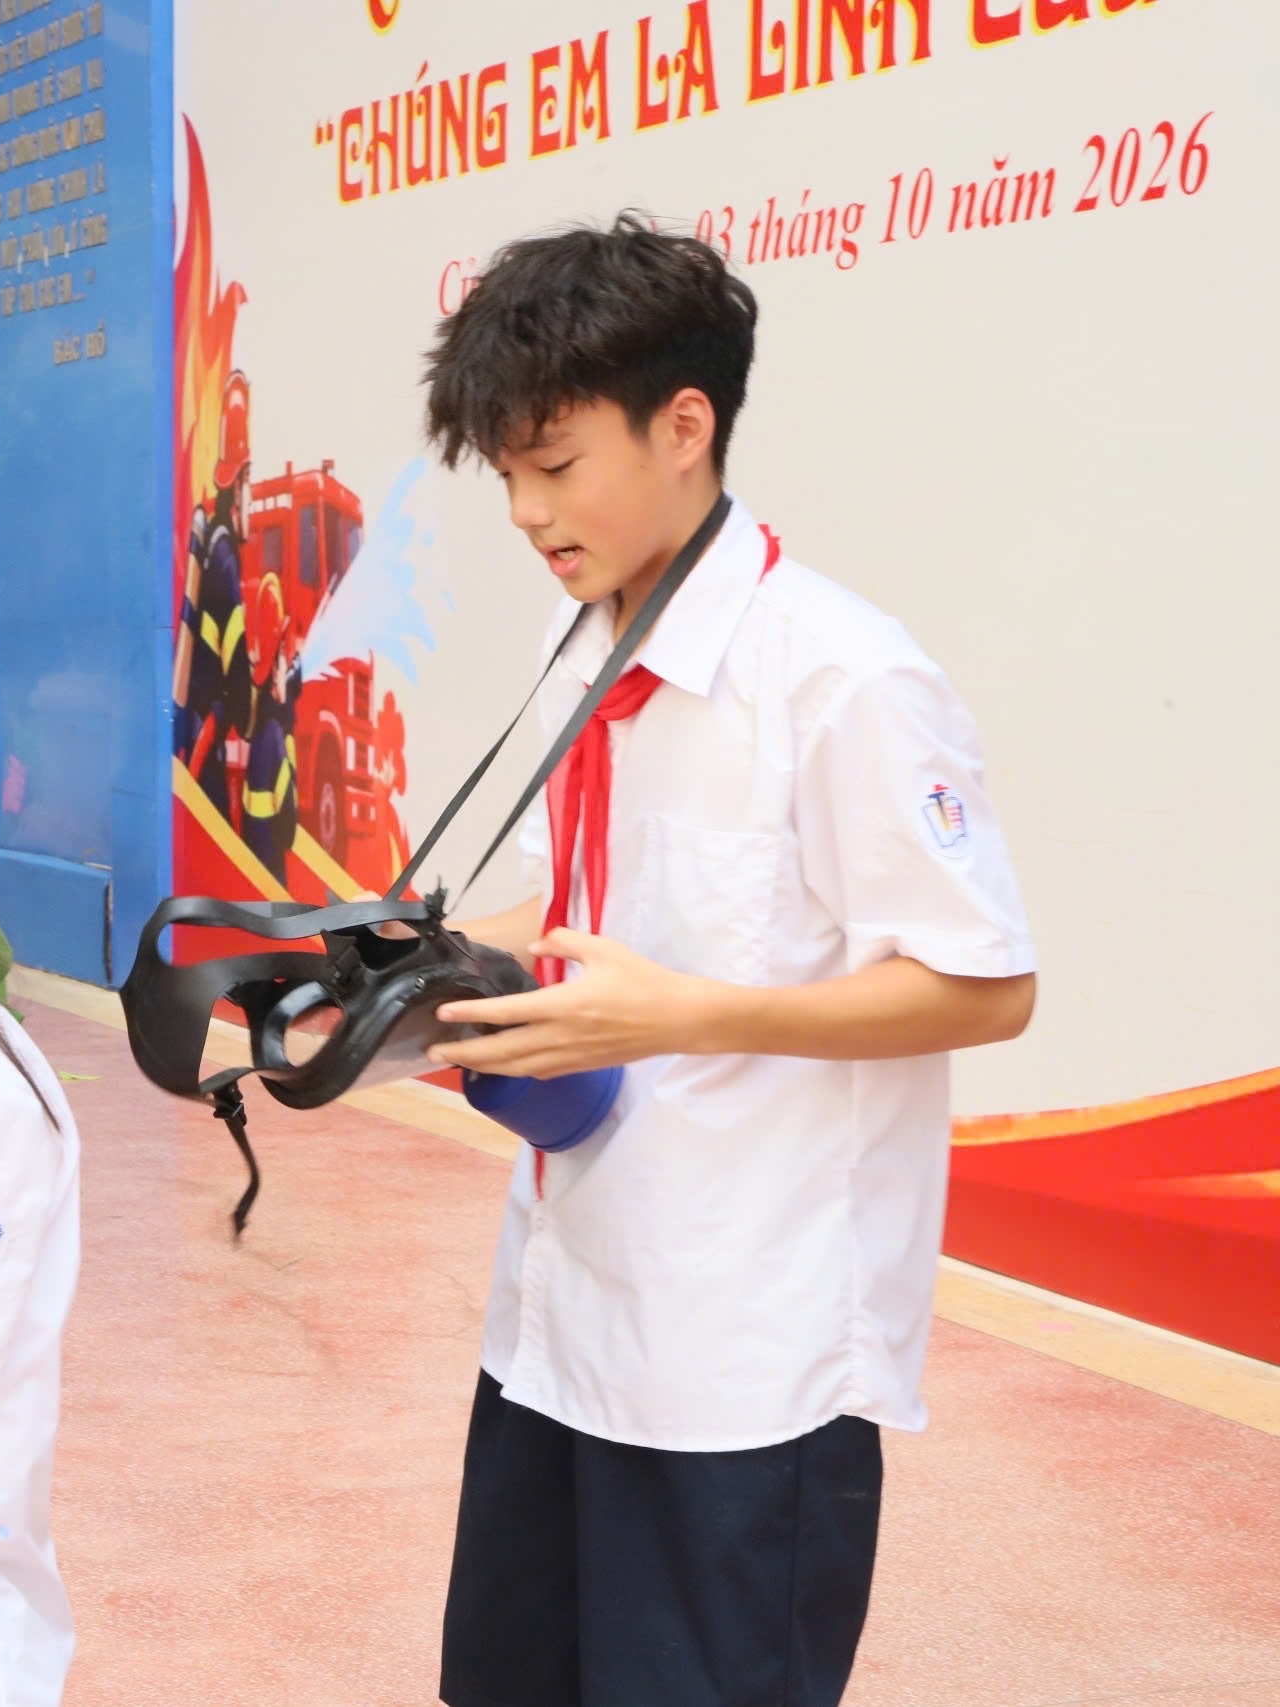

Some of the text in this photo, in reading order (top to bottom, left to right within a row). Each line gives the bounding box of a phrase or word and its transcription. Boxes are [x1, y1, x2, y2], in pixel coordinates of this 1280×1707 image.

[528, 29, 612, 160] EM
[746, 188, 867, 272] tháng
[880, 166, 935, 244] 10
[946, 155, 1057, 234] năm
[1072, 111, 1215, 214] 2026
